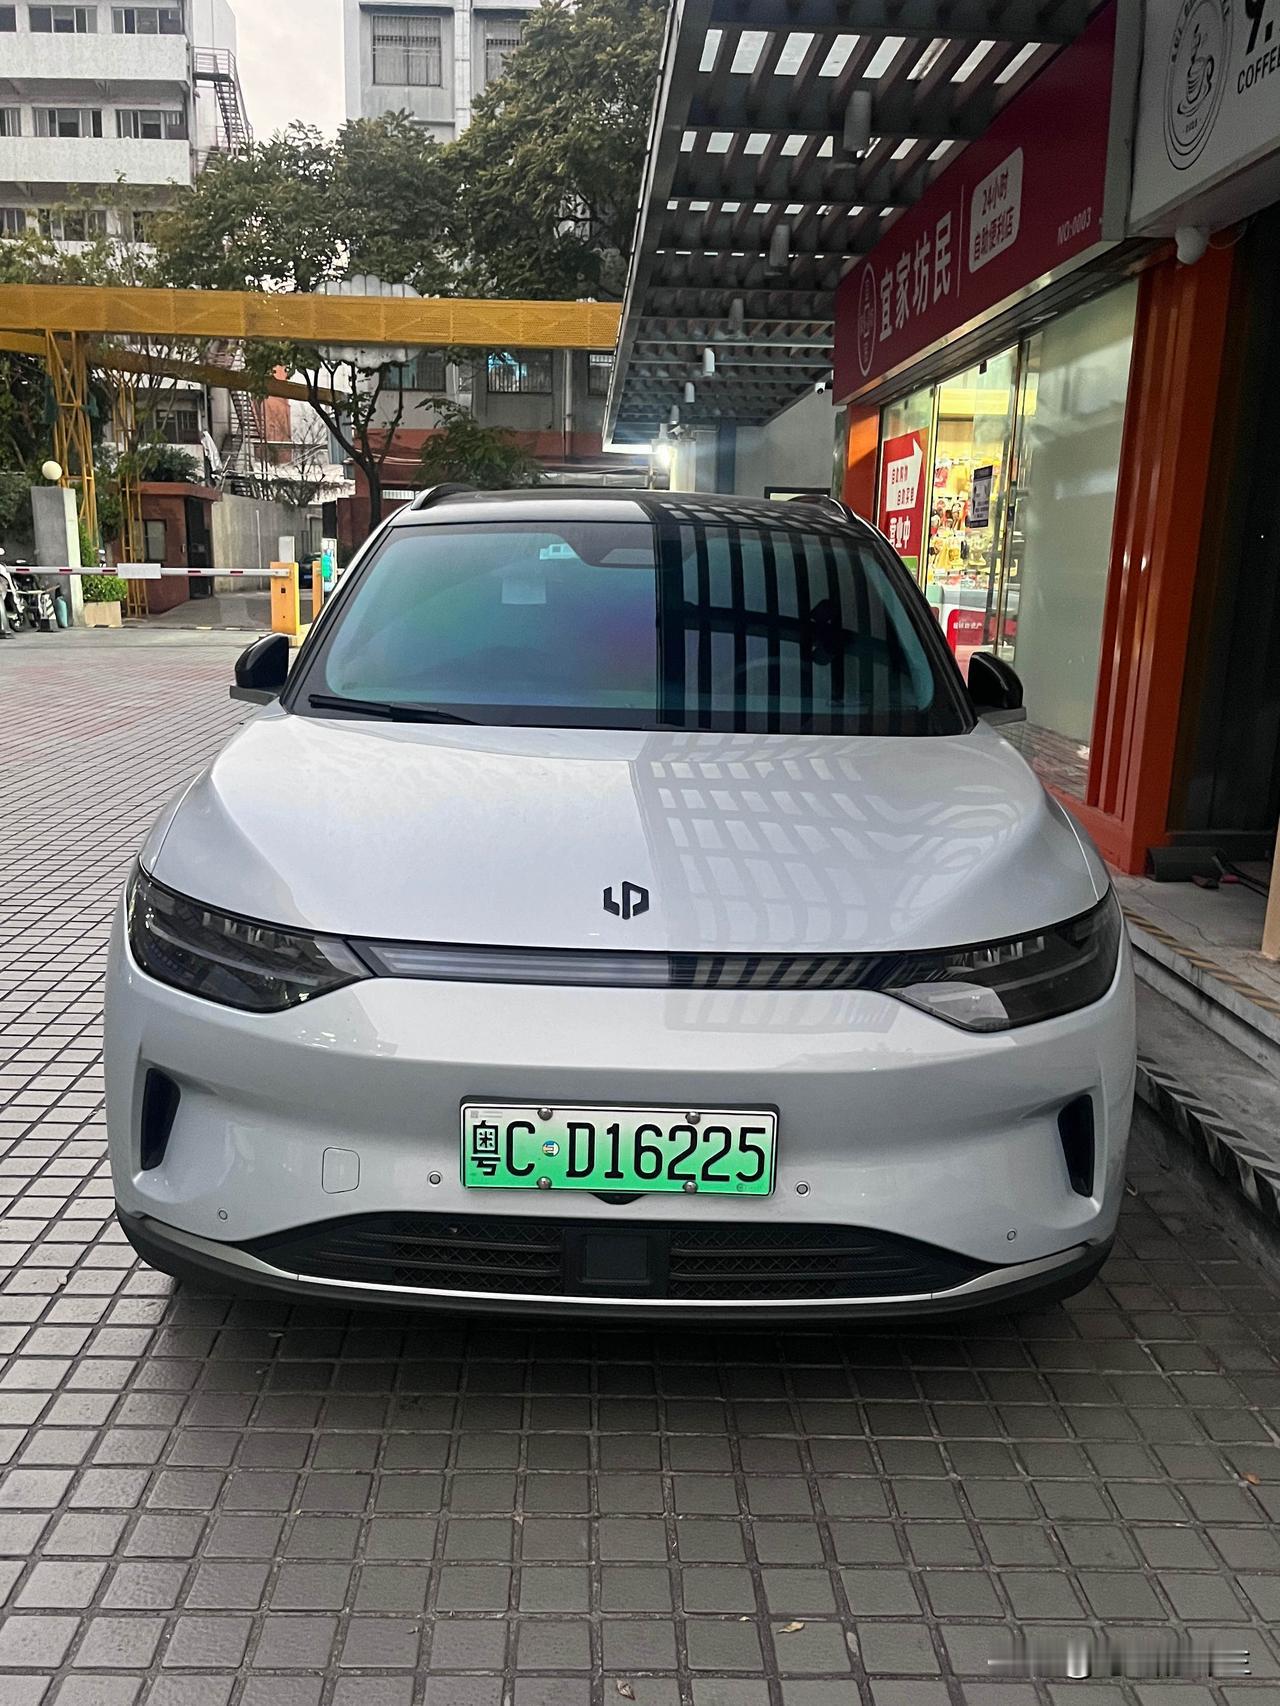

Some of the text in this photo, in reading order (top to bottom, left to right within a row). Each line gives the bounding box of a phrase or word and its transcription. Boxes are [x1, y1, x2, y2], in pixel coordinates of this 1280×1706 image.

[981, 168, 1009, 216] 24小时
[974, 206, 1015, 261] 自助便利店
[880, 210, 951, 342] 宜家坊民
